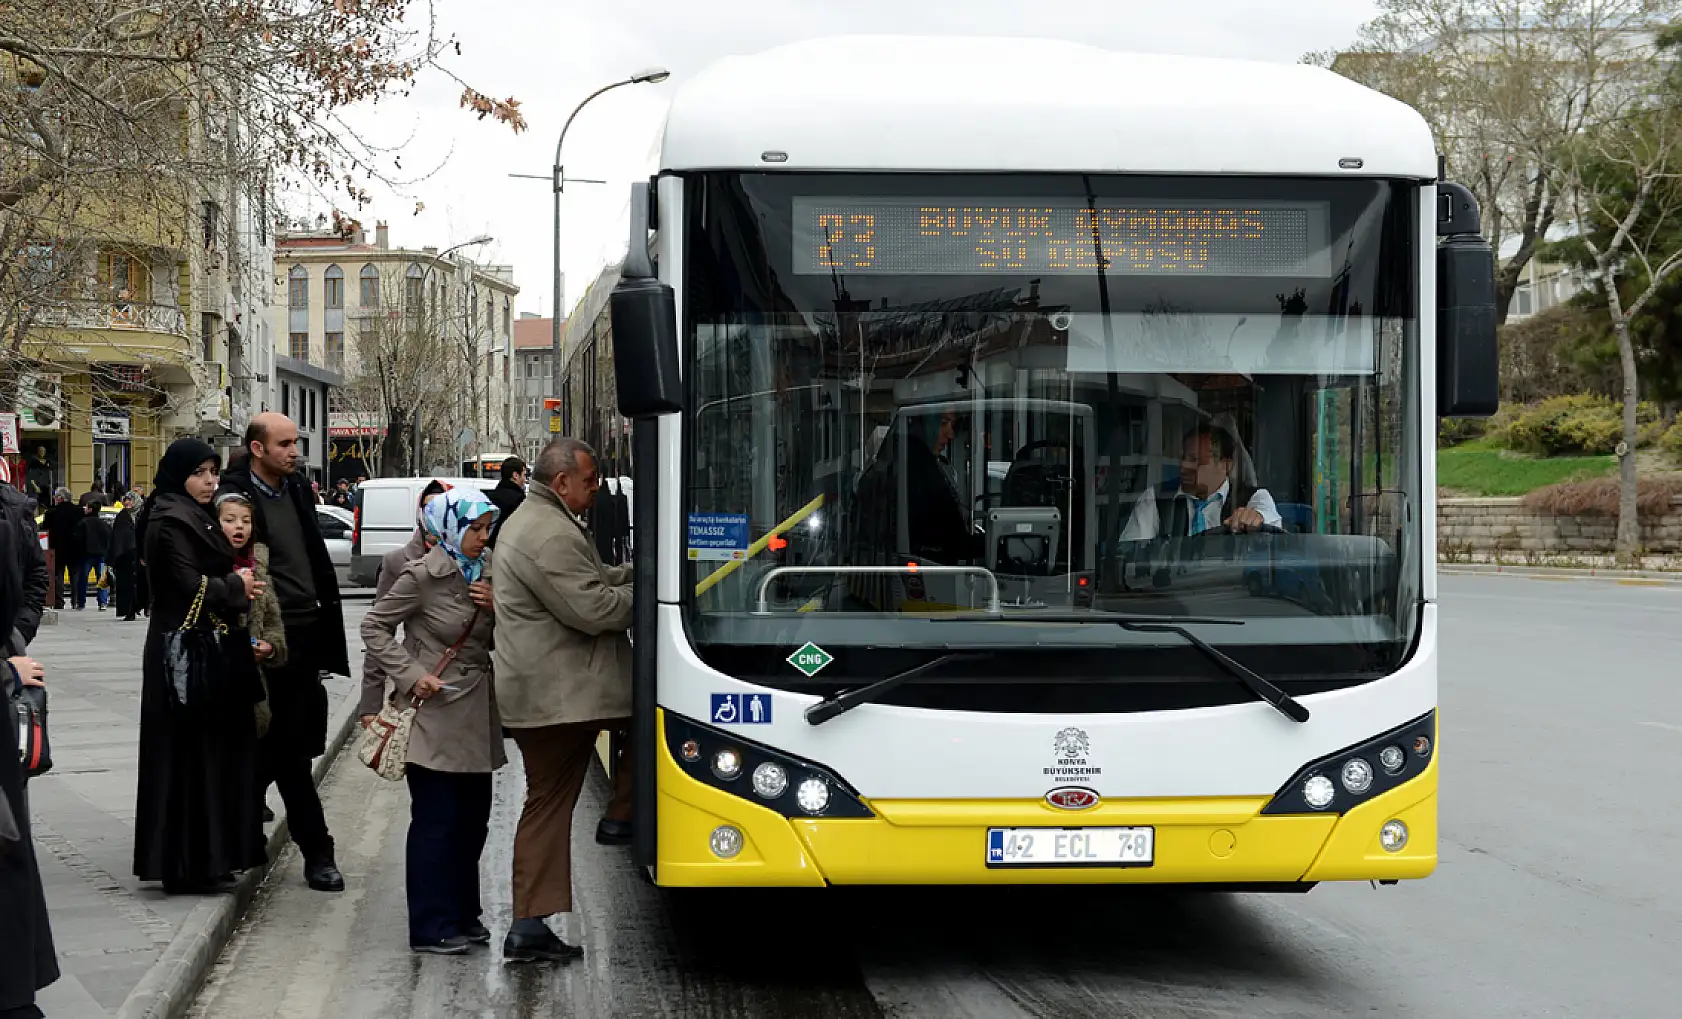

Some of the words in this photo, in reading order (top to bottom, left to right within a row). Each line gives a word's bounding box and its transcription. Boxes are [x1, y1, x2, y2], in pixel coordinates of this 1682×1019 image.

[819, 215, 875, 267] 23
[975, 239, 1027, 267] SU
[1049, 240, 1208, 269] DEPOSU
[798, 654, 822, 665] CNG
[1057, 758, 1087, 766] KONYA
[990, 848, 1003, 858] TR
[1005, 834, 1035, 858] 42
[1054, 834, 1097, 858] ECL
[1118, 834, 1147, 858] 78
